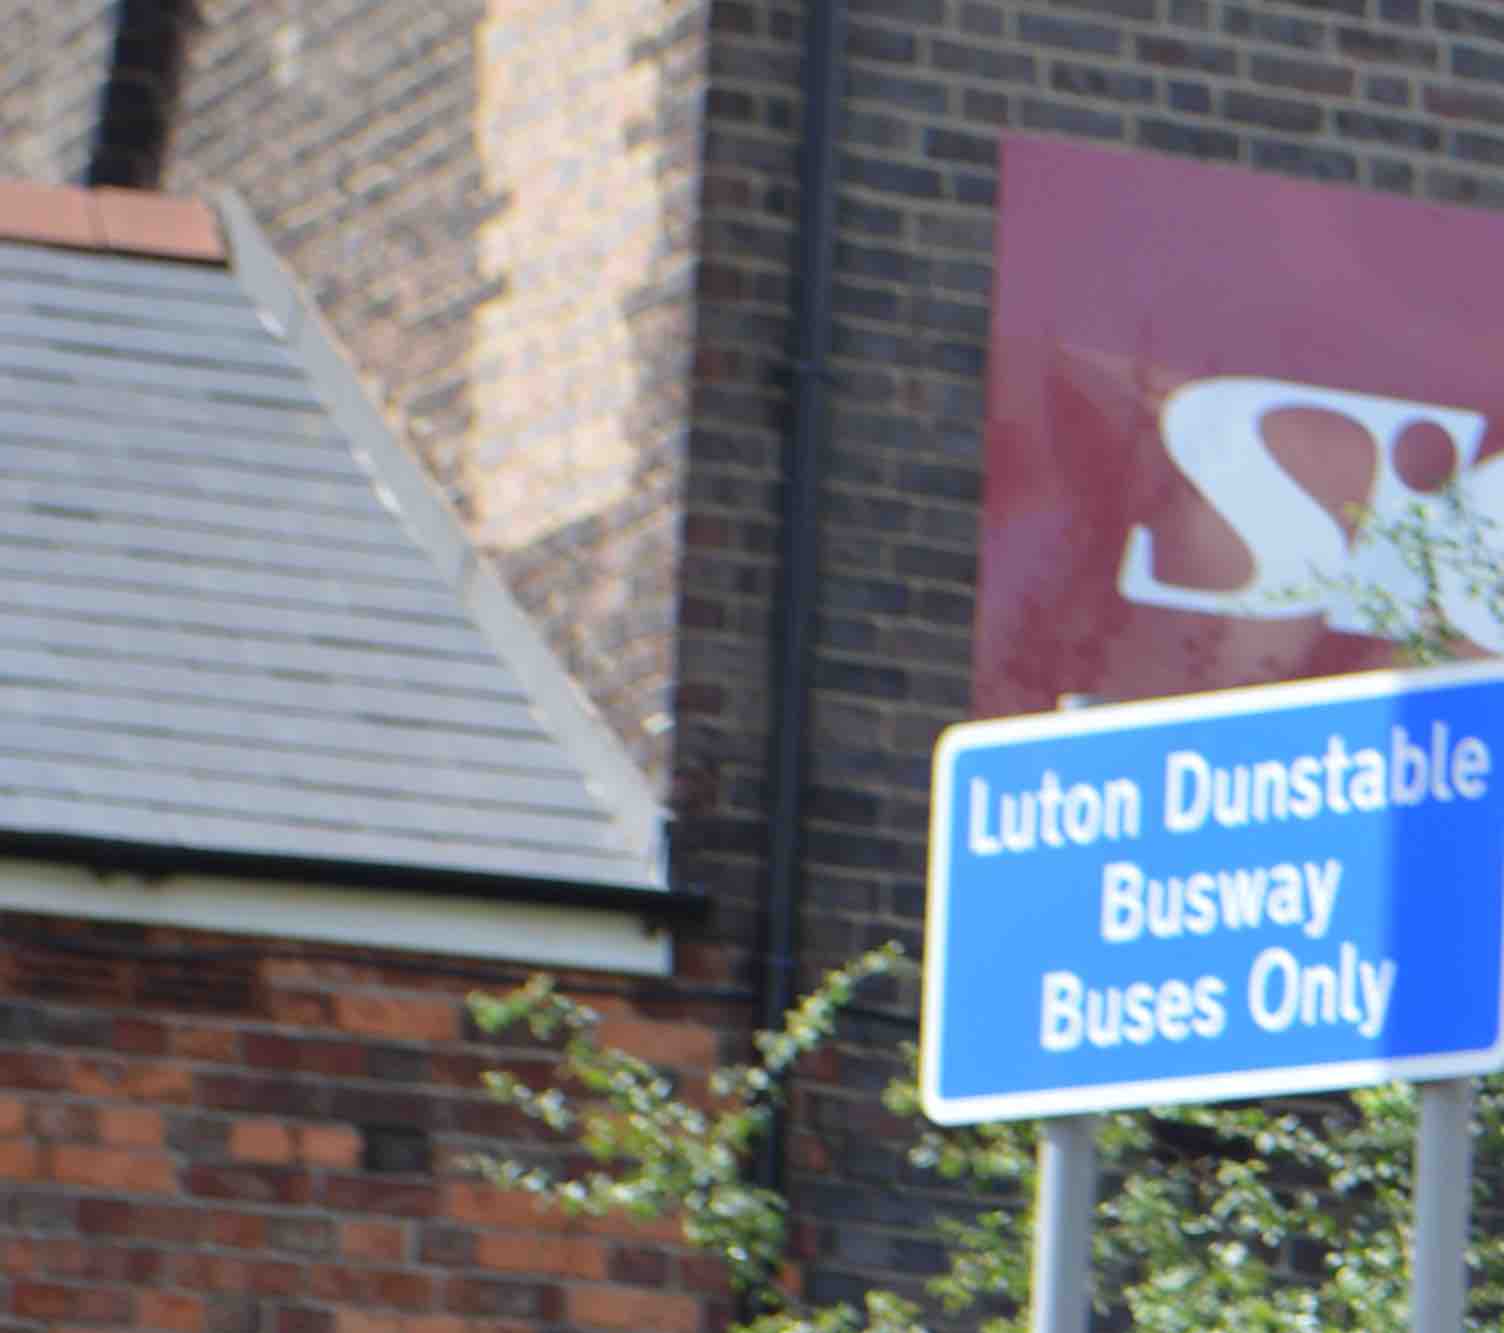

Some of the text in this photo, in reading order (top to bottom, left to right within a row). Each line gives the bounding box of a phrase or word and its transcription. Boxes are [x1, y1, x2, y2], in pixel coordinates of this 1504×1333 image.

[968, 720, 1493, 857] Luton Dunstable
[1101, 858, 1343, 943] Busway
[1040, 942, 1398, 1053] Buses Only
